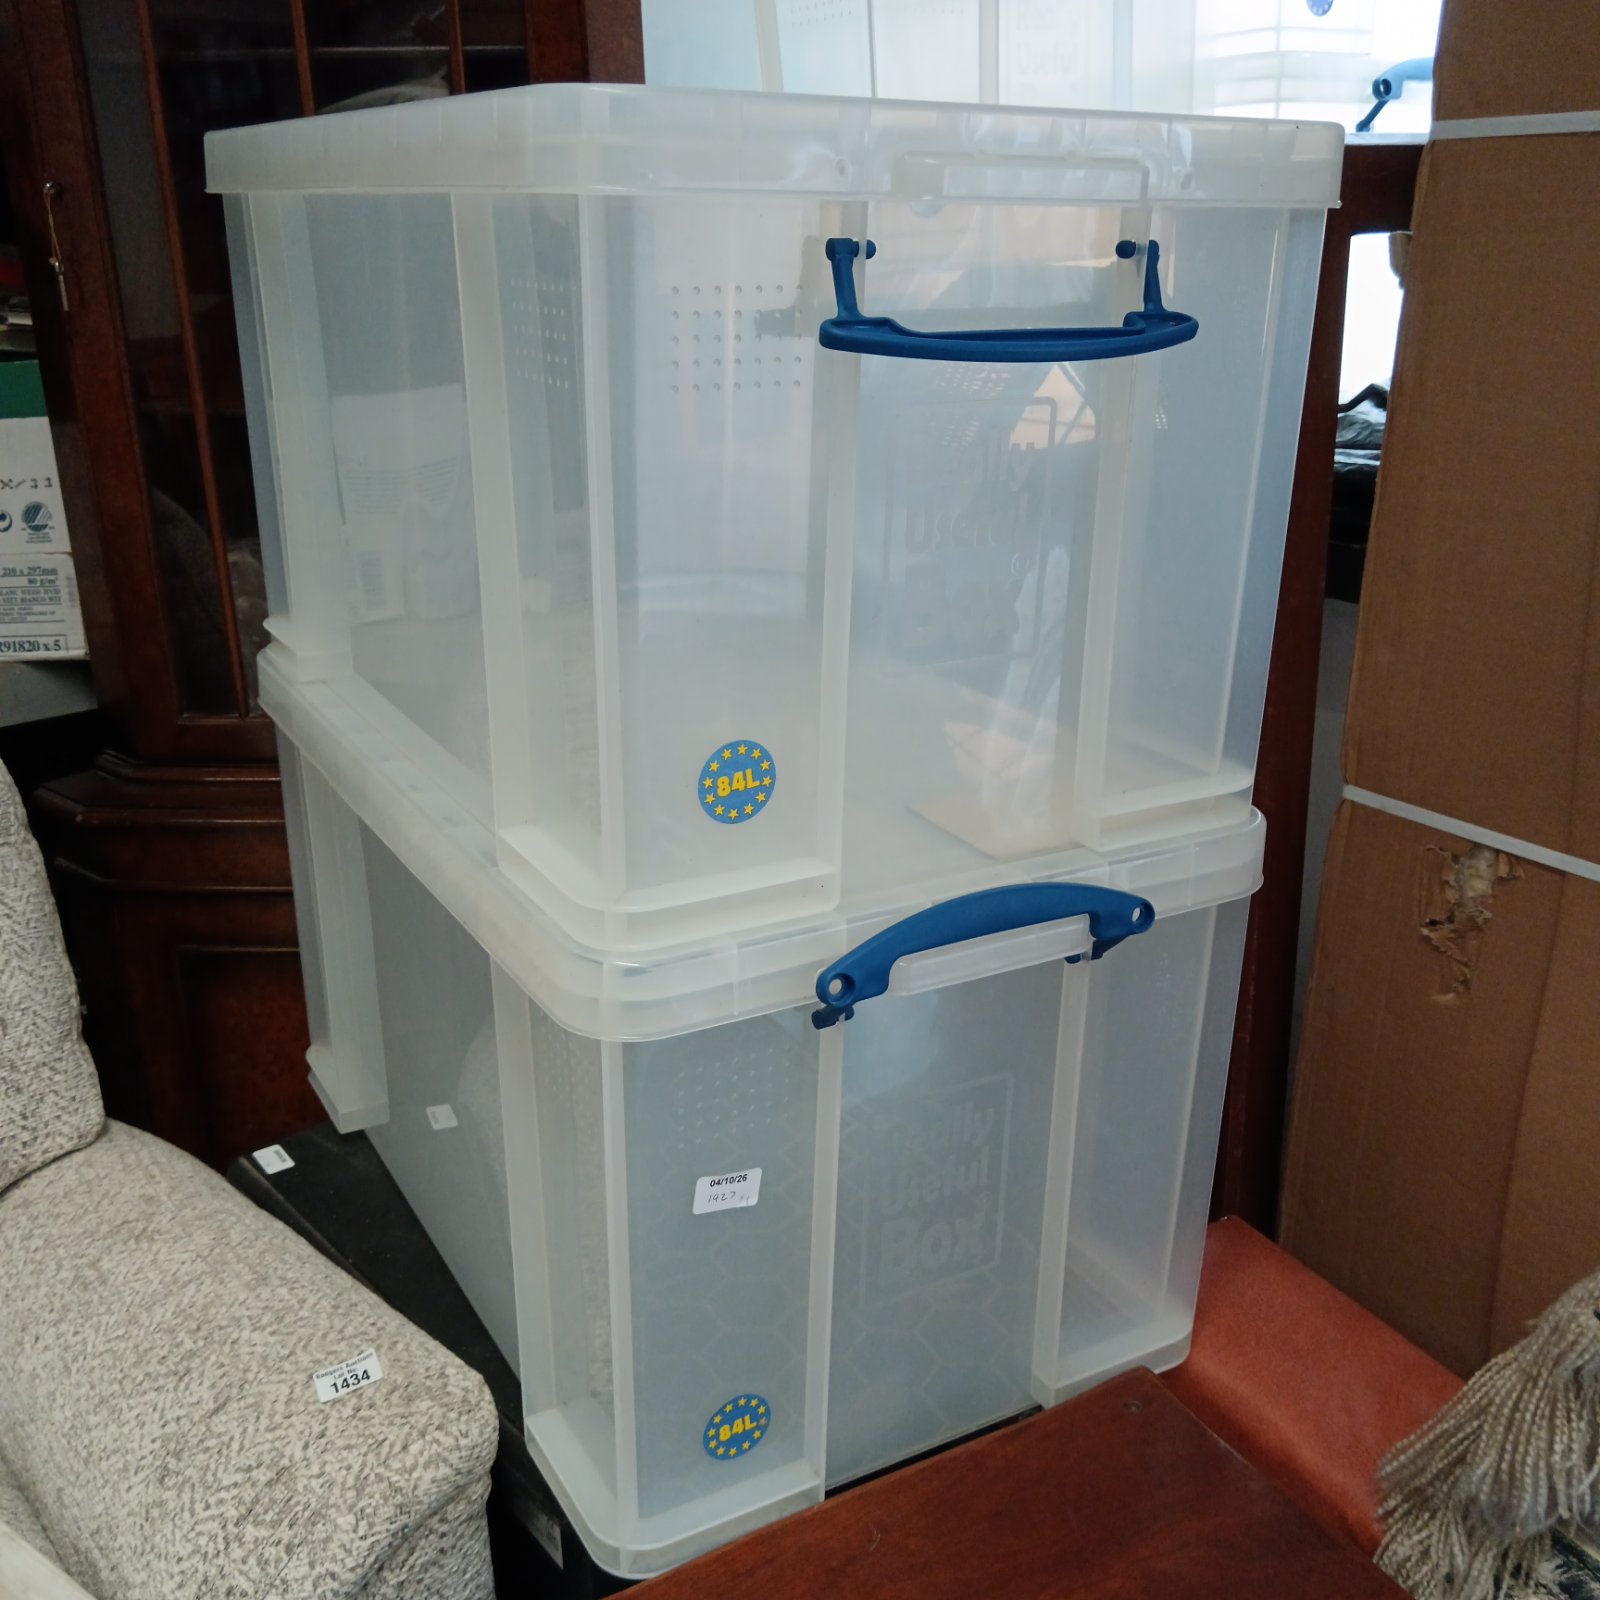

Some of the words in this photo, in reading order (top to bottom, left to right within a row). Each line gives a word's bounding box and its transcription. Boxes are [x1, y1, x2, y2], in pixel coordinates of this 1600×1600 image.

[53, 639, 61, 652] 5
[717, 768, 760, 797] 84L
[710, 1173, 748, 1188] 04/10/26
[331, 1369, 371, 1393] 1434
[719, 1414, 757, 1442] 84L
